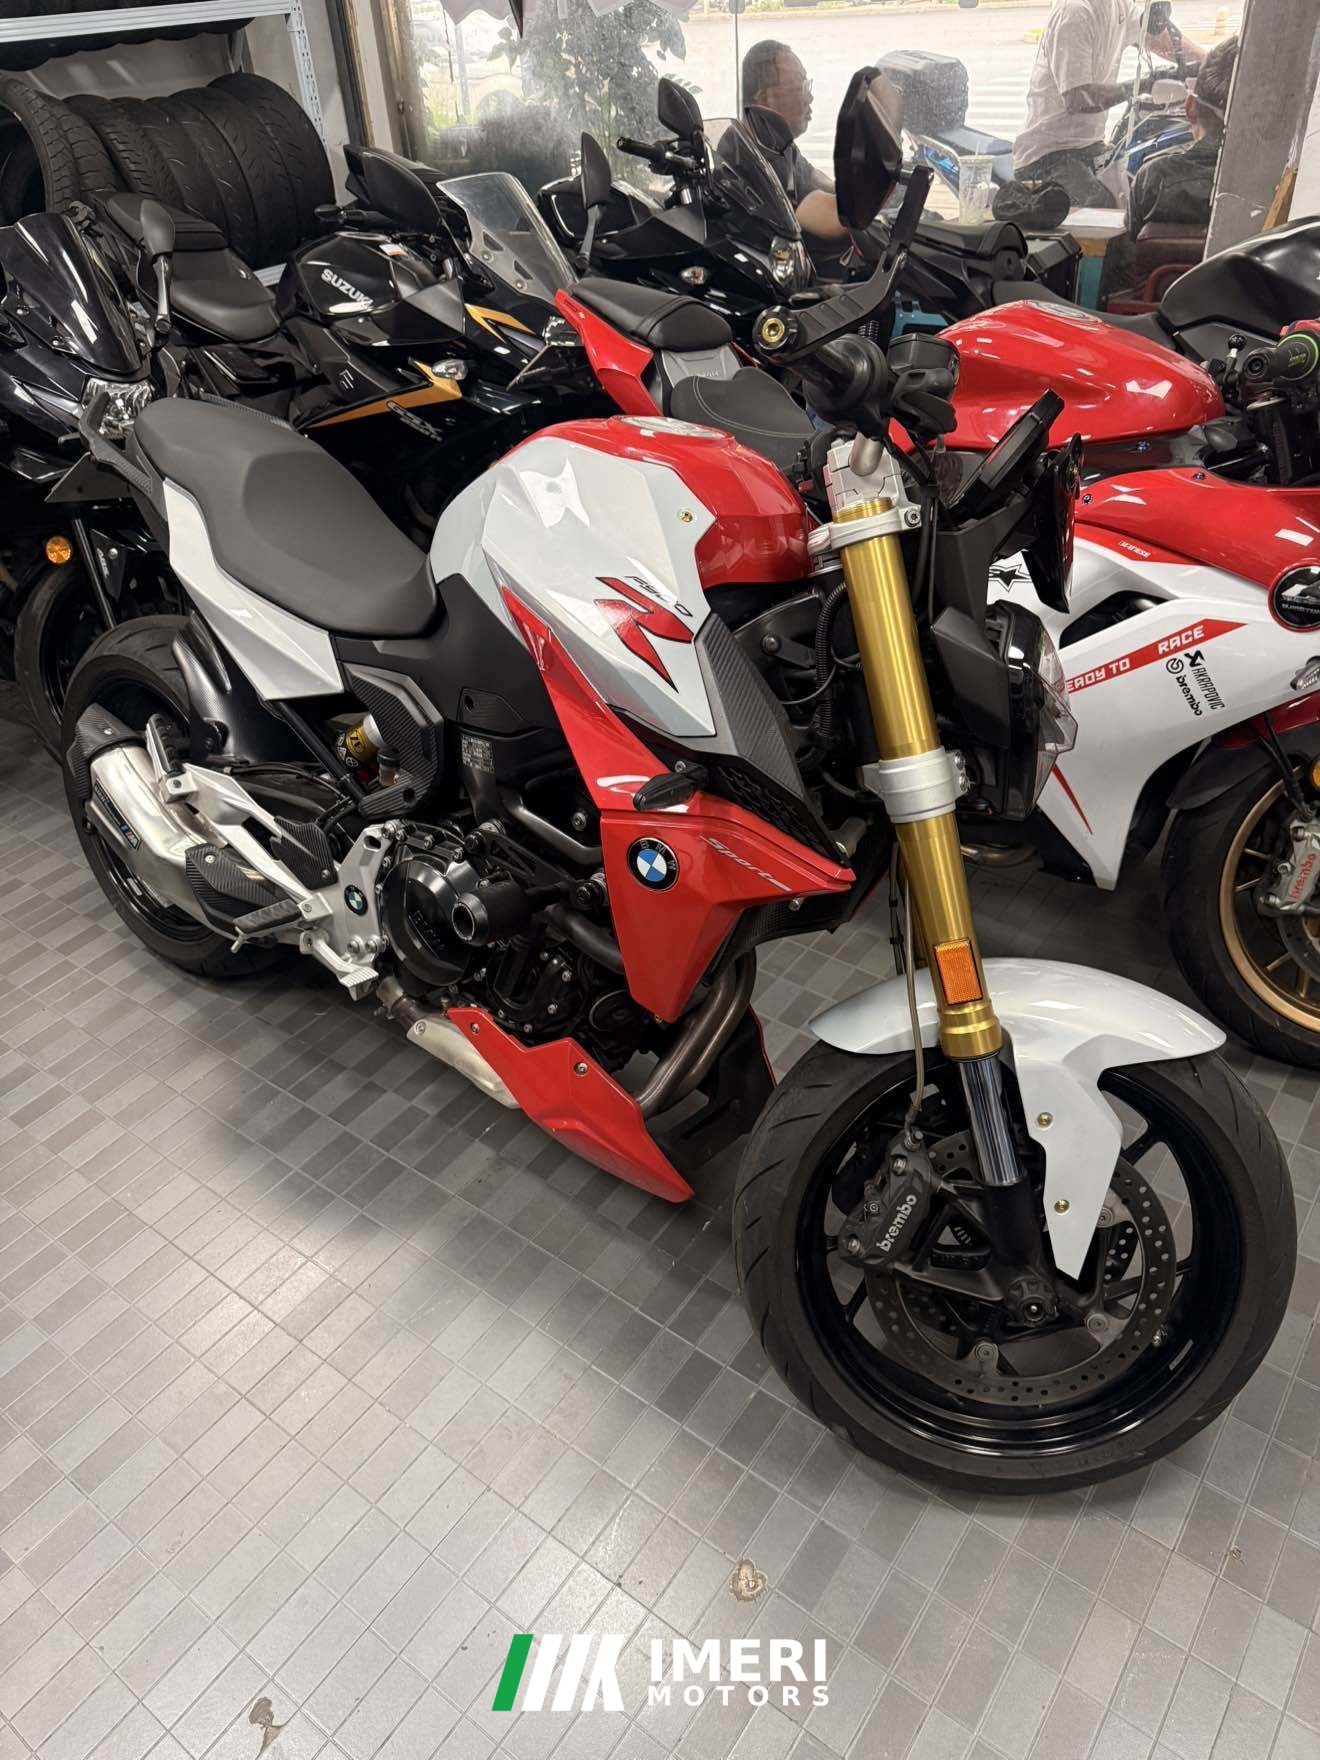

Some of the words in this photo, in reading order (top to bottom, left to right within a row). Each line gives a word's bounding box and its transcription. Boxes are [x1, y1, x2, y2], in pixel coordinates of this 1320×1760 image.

[321, 268, 374, 309] SUZUKI
[1065, 670, 1106, 692] EADY
[1109, 657, 1131, 675] TO
[1157, 625, 1205, 655] RACE
[1176, 674, 1203, 716] brembo
[640, 840, 677, 871] BMW
[702, 837, 782, 886] Sport
[876, 1194, 917, 1252] brembo
